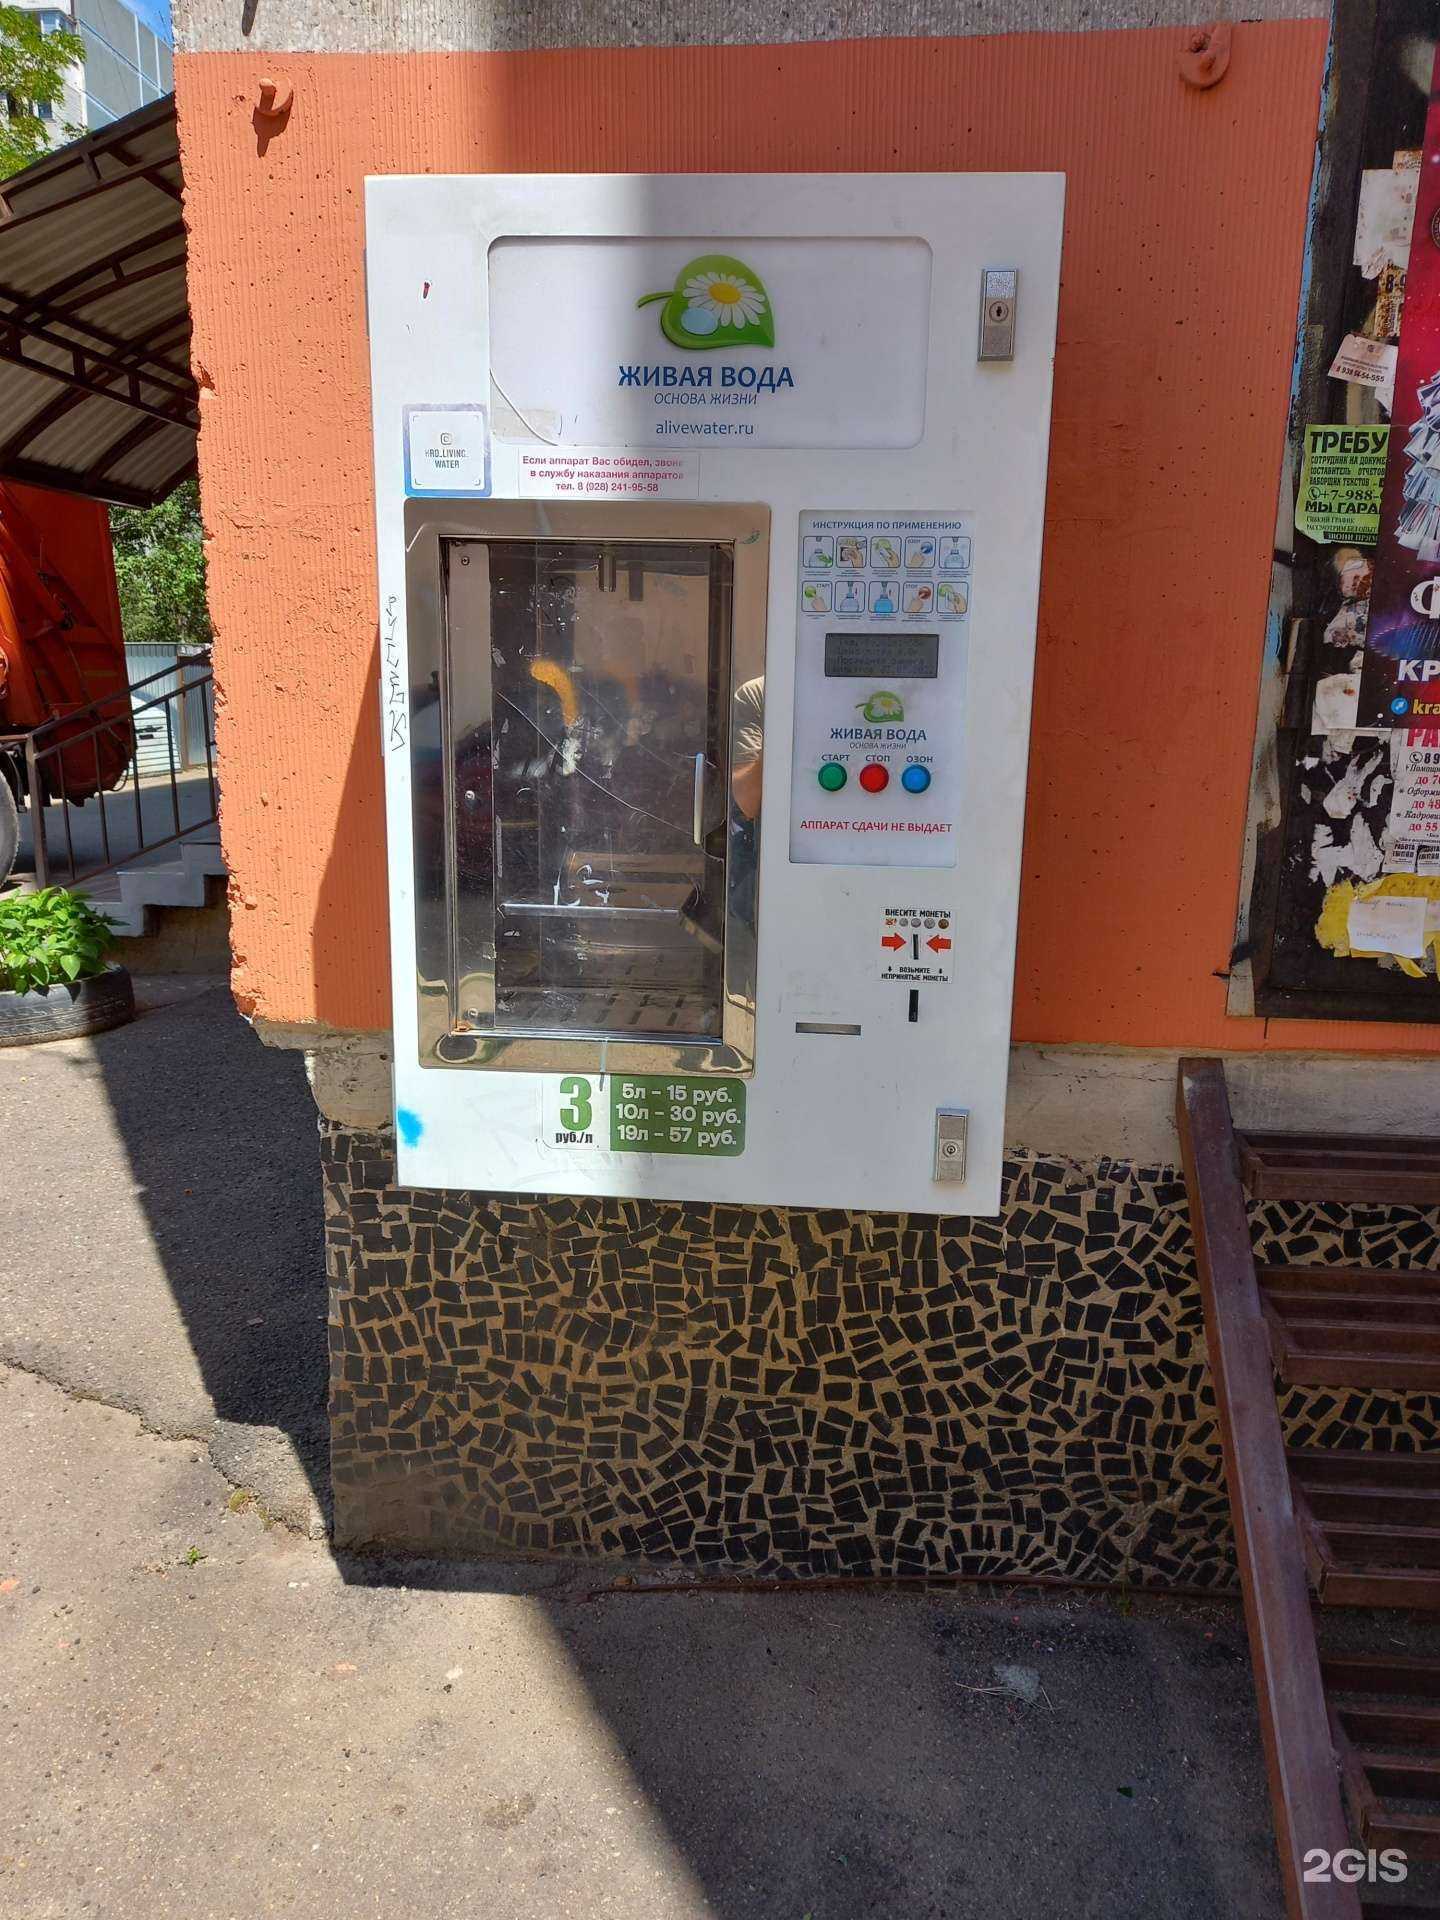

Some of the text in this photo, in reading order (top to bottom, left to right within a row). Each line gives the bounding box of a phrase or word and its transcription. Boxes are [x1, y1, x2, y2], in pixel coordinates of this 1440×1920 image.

[618, 365, 795, 393] ЖИВАЯ ВОДА
[654, 392, 758, 405] ОСНОВА ЖИЗНИ
[656, 420, 754, 435] alivewater.ru
[1310, 431, 1388, 454] ТРЕБУ
[434, 460, 460, 468] WATER
[522, 456, 547, 465] Если
[549, 457, 588, 467] аппарат
[592, 457, 611, 466] Вас
[613, 456, 653, 468] обидел,
[538, 470, 575, 480] службу
[577, 471, 629, 479] наказания
[555, 482, 575, 491] тел.
[577, 482, 583, 491] 8
[611, 483, 659, 492] 241-95-58
[1305, 500, 1378, 514] МЫ ГАРА
[812, 520, 962, 530] ИНСТРУКЦИЯ ПО ПРИМЕНЕНИЮ
[1397, 659, 1440, 682] КР
[830, 727, 927, 743] ЖИВАЯ ВОДА
[821, 754, 850, 762] СТАРТ
[906, 755, 933, 763] ОЗОН
[800, 821, 953, 834] АППАРАТ СДАЧИ НЕ ВЫДАЕТ
[885, 908, 951, 918] ВНЕСИТЕ МОНЕТЫ
[881, 973, 921, 981] НЕПРИНЯТЫЕ
[622, 1083, 646, 1100] 5л
[667, 1085, 687, 1100] 15
[693, 1087, 733, 1105] руб.
[559, 1076, 592, 1132] 3
[616, 1103, 649, 1120] 10л
[670, 1106, 696, 1121] 30
[702, 1109, 741, 1126] руб.
[555, 1131, 593, 1143] руб./л
[617, 1124, 649, 1141] 19л
[669, 1127, 692, 1143] 57
[697, 1129, 737, 1148] руб.
